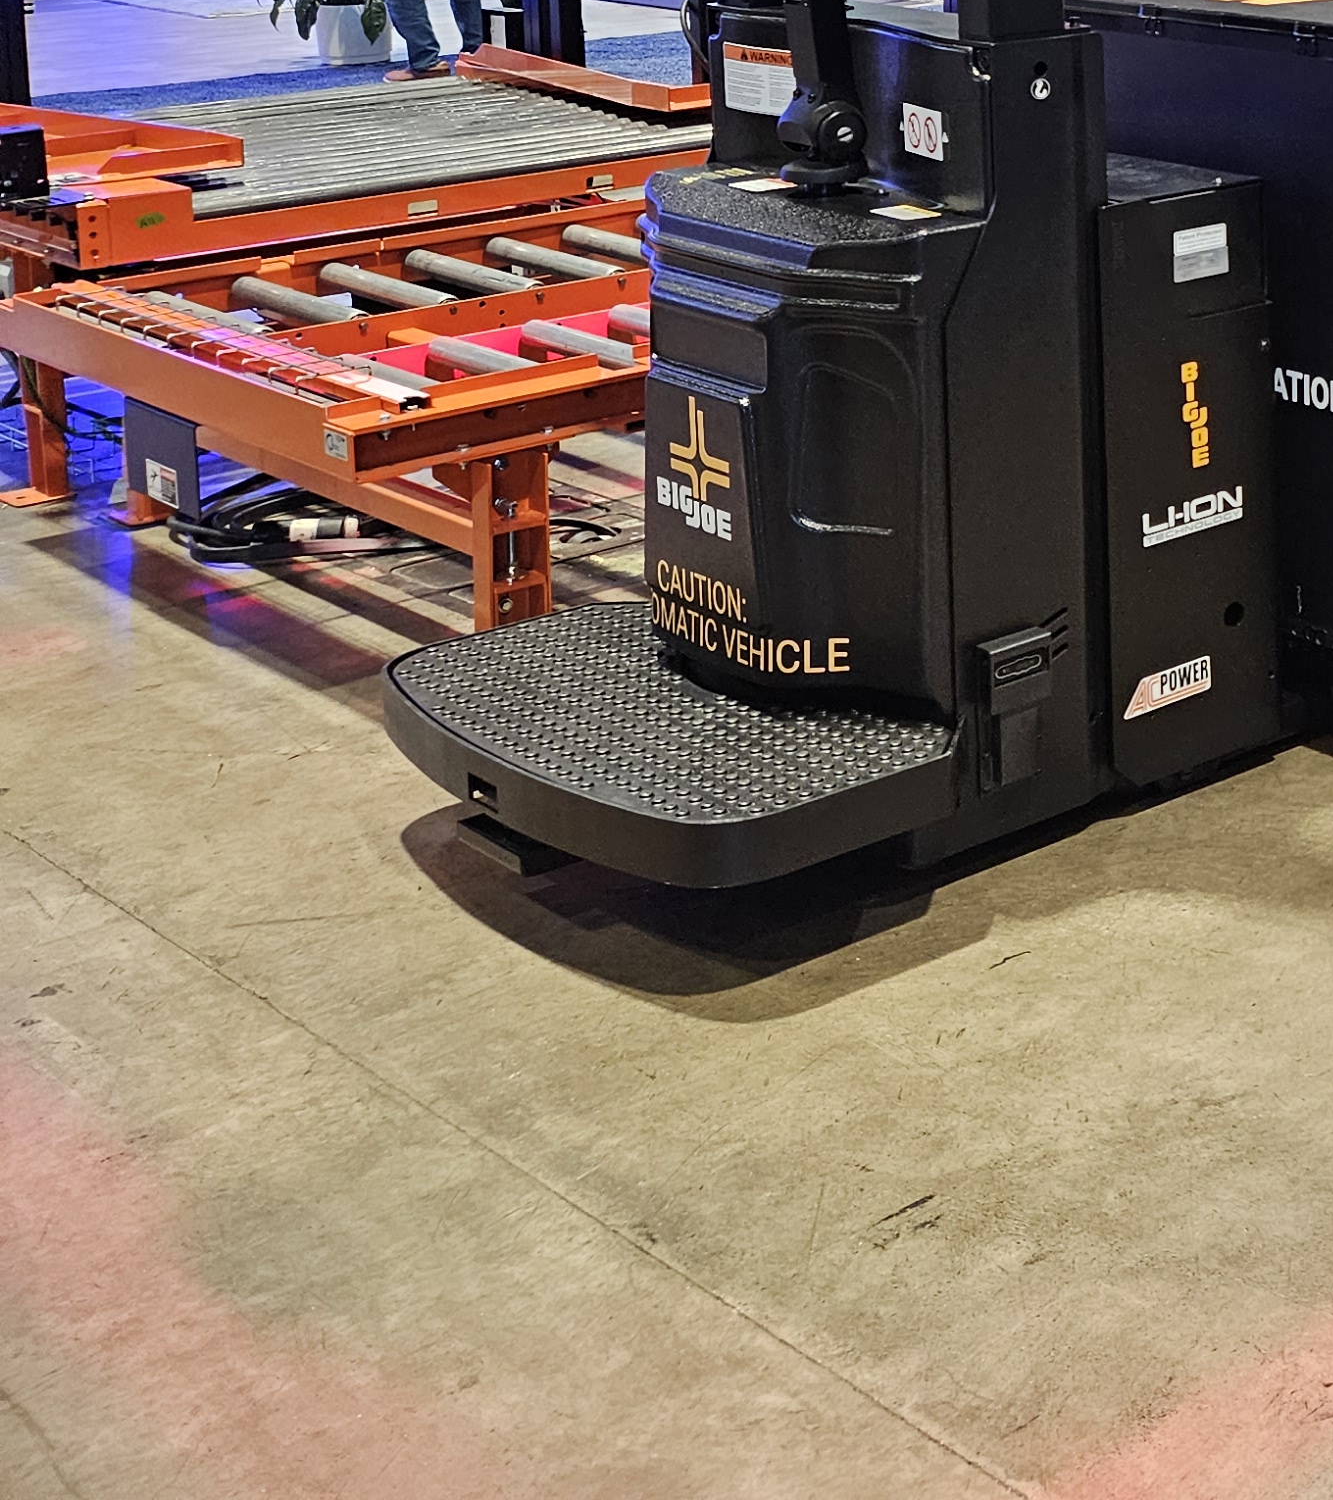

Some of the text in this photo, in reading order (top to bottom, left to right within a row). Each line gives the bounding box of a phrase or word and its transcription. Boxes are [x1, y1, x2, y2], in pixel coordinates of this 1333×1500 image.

[1145, 509, 1241, 545] TECHNOLOGY
[657, 559, 748, 623] CAUTION:
[722, 625, 852, 675] VEHICLE
[1160, 658, 1210, 696] POWER
